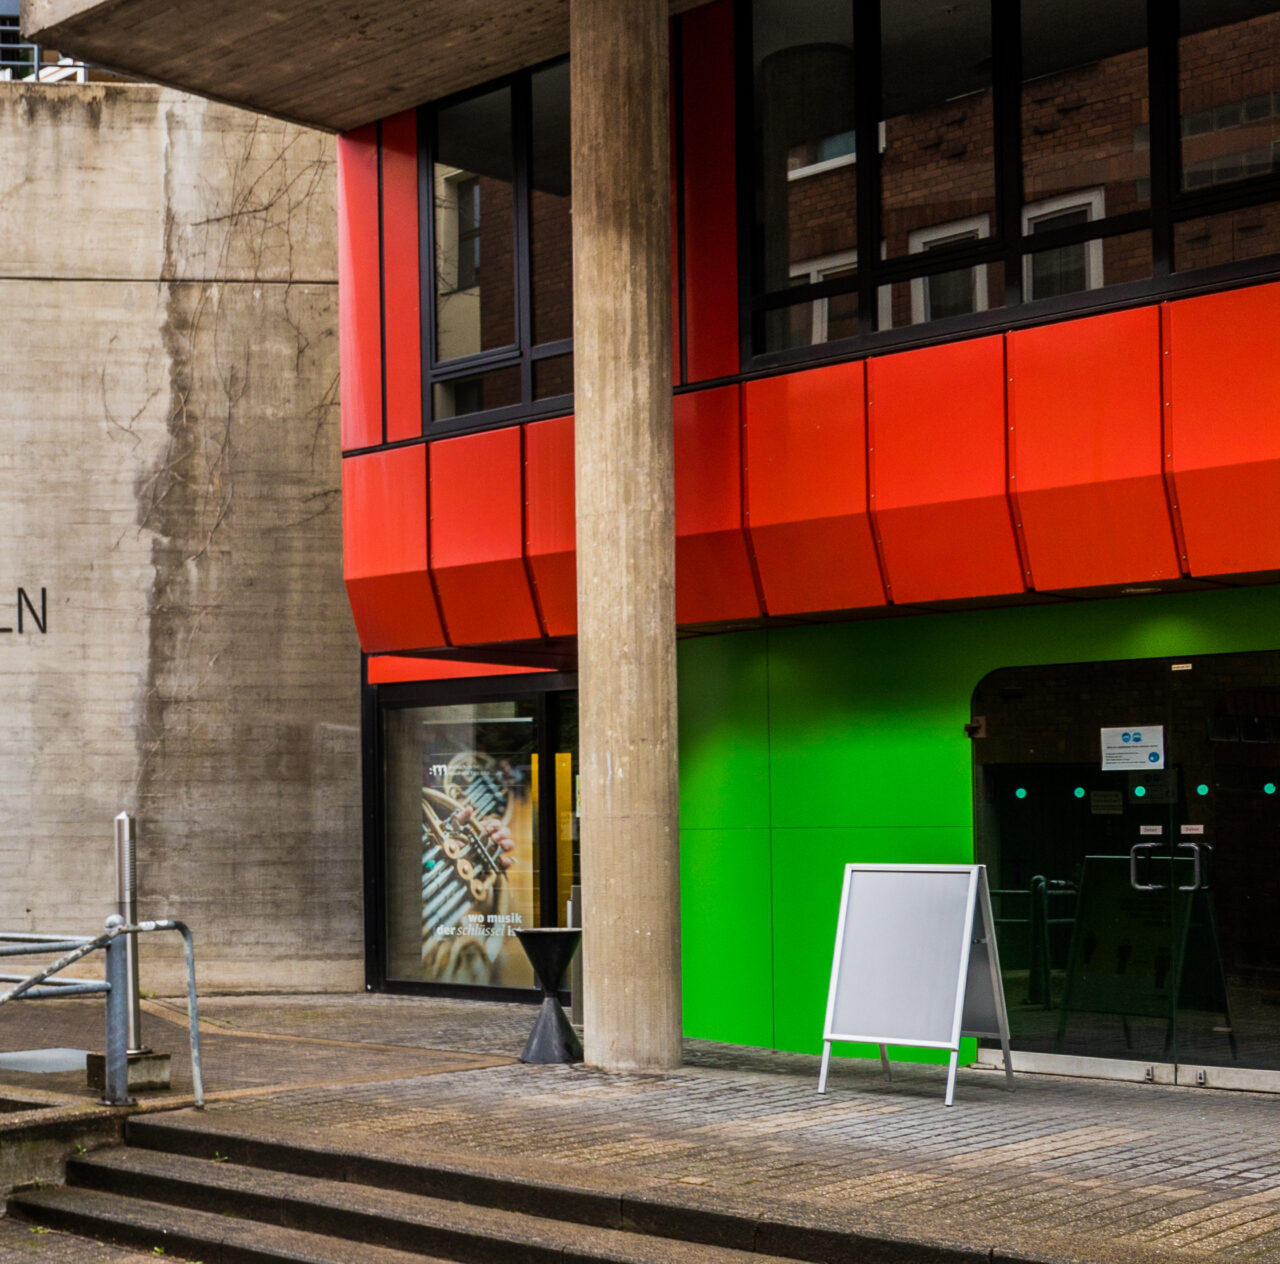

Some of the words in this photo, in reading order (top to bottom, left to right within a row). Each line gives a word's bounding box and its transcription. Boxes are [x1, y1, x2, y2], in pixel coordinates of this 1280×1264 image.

[467, 914, 485, 923] wo
[486, 912, 523, 924] musik
[436, 924, 456, 936] der
[456, 924, 506, 936] schlüssel
